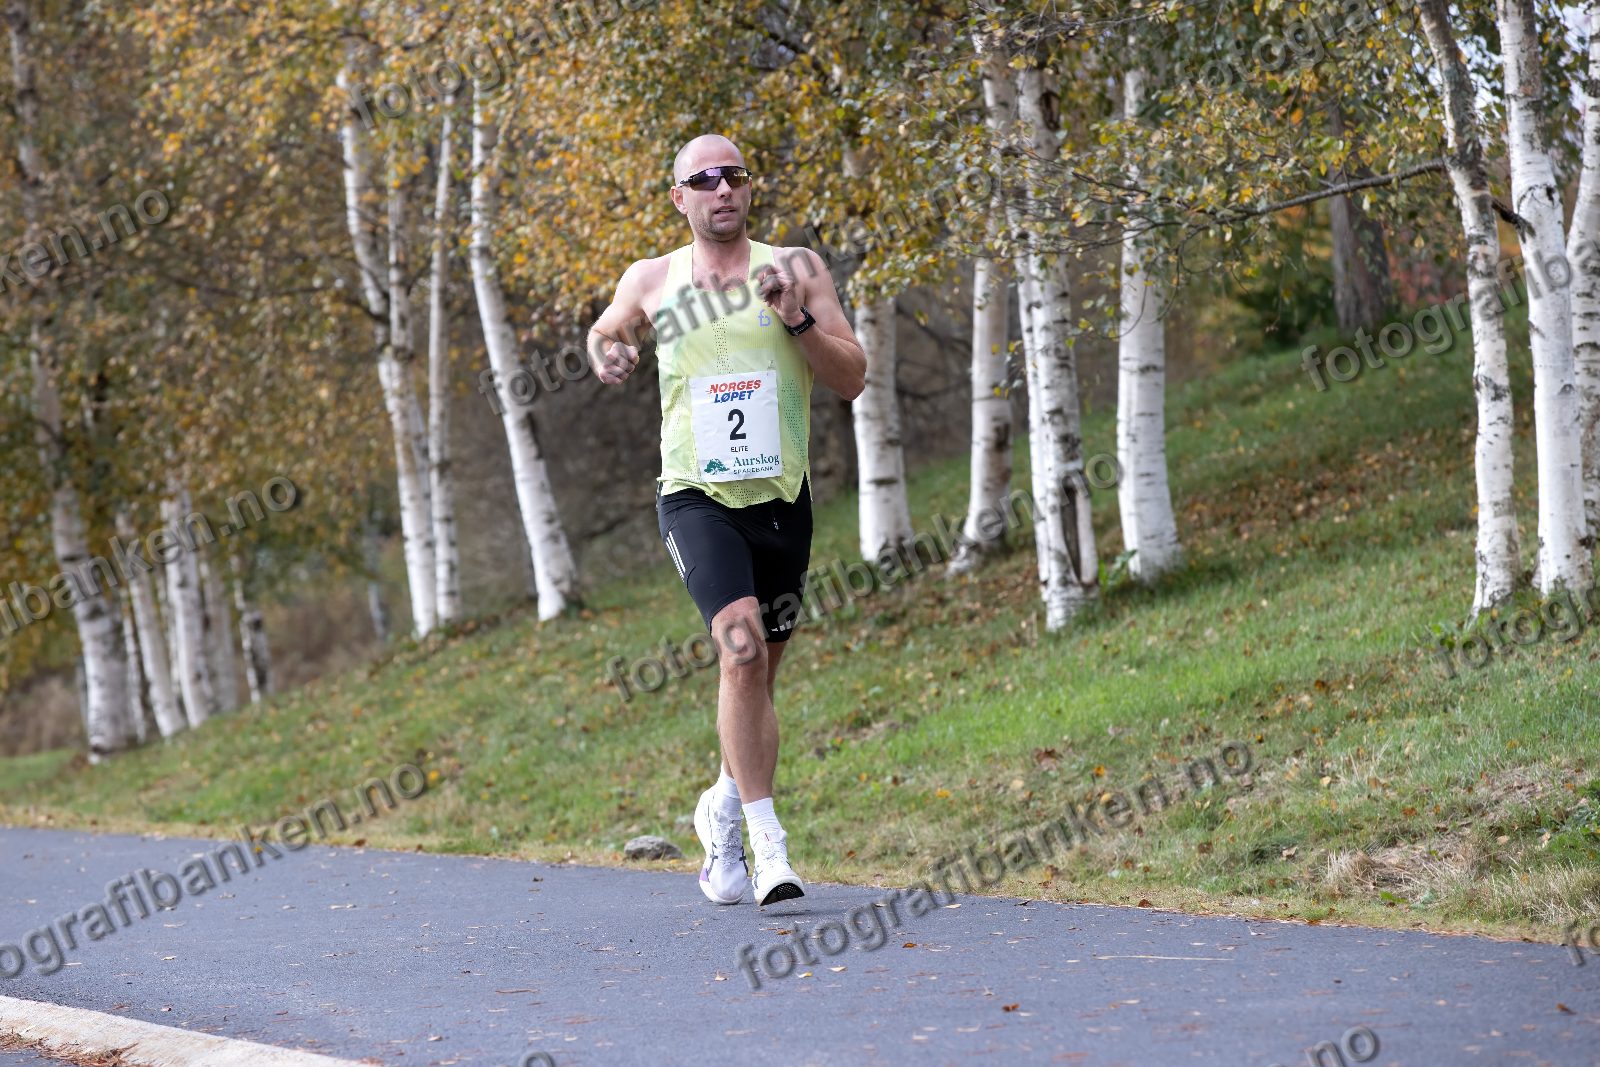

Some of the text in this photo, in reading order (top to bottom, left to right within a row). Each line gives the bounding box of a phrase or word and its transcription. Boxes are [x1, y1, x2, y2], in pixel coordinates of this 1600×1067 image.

[709, 380, 762, 394] NORGES
[714, 390, 754, 403] LØPET
[728, 409, 746, 440] 2
[733, 454, 780, 467] Aurskog
